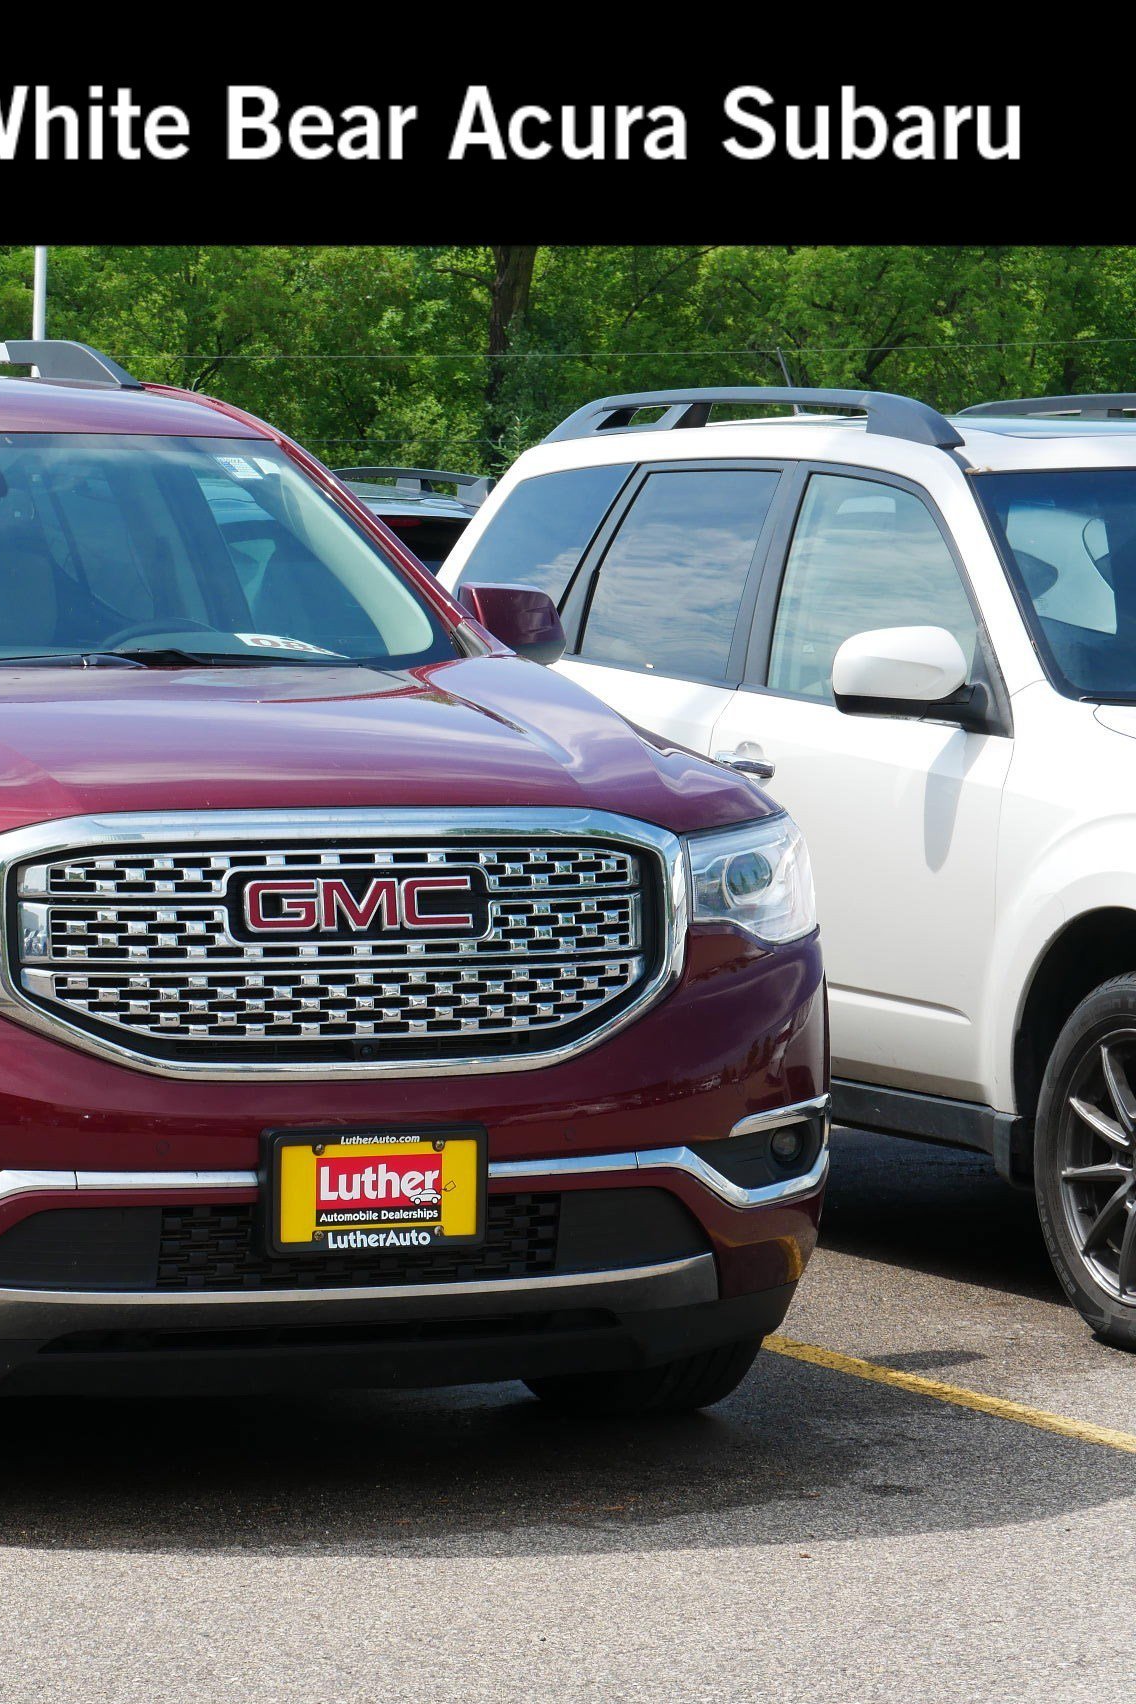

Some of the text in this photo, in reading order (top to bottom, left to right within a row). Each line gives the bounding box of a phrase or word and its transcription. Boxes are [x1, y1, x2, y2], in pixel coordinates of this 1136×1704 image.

[244, 877, 474, 933] GMC
[340, 1134, 420, 1145] LutherAuto.com
[320, 1163, 440, 1200] Luther
[319, 1208, 439, 1223] Automobile Dealerships
[327, 1229, 431, 1249] LutherAuto
